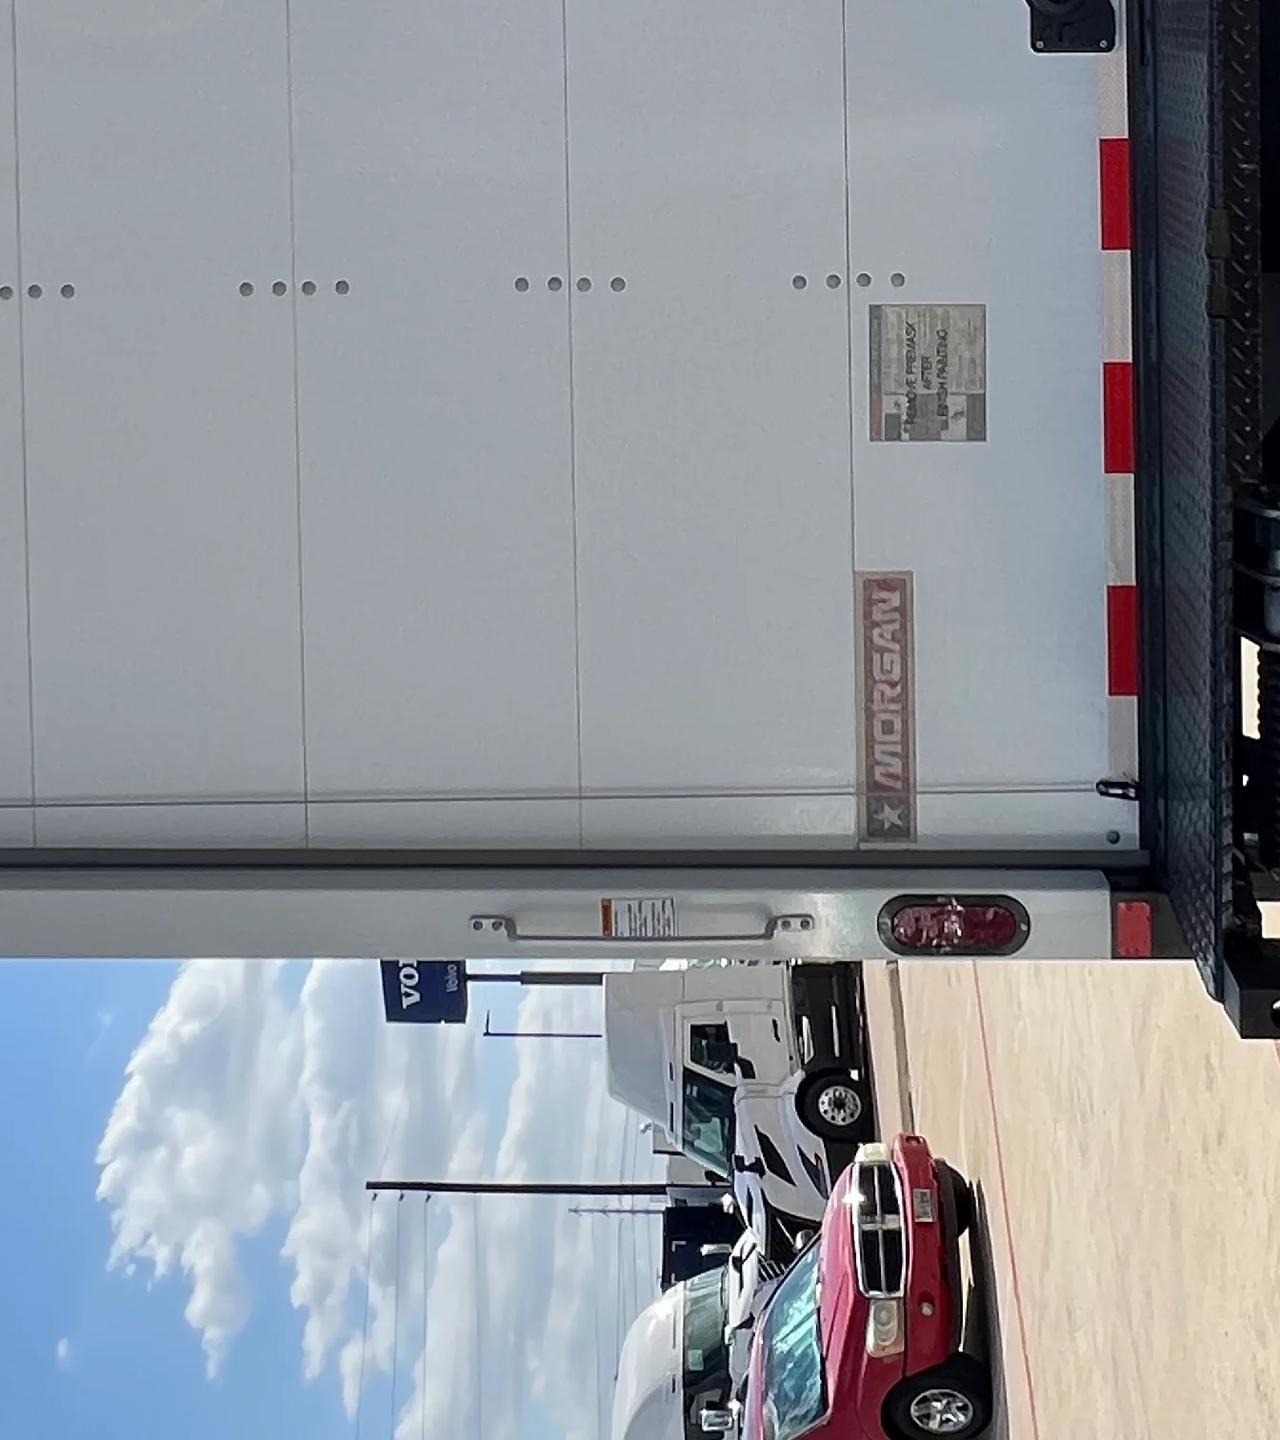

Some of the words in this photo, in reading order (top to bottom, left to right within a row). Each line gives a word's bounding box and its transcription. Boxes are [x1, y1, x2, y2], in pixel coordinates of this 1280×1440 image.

[905, 321, 916, 375] PREMASK
[921, 356, 932, 390] AFTER
[937, 329, 948, 380] PAINTING
[905, 379, 917, 424] REMOVE
[871, 590, 902, 790] MORGAN
